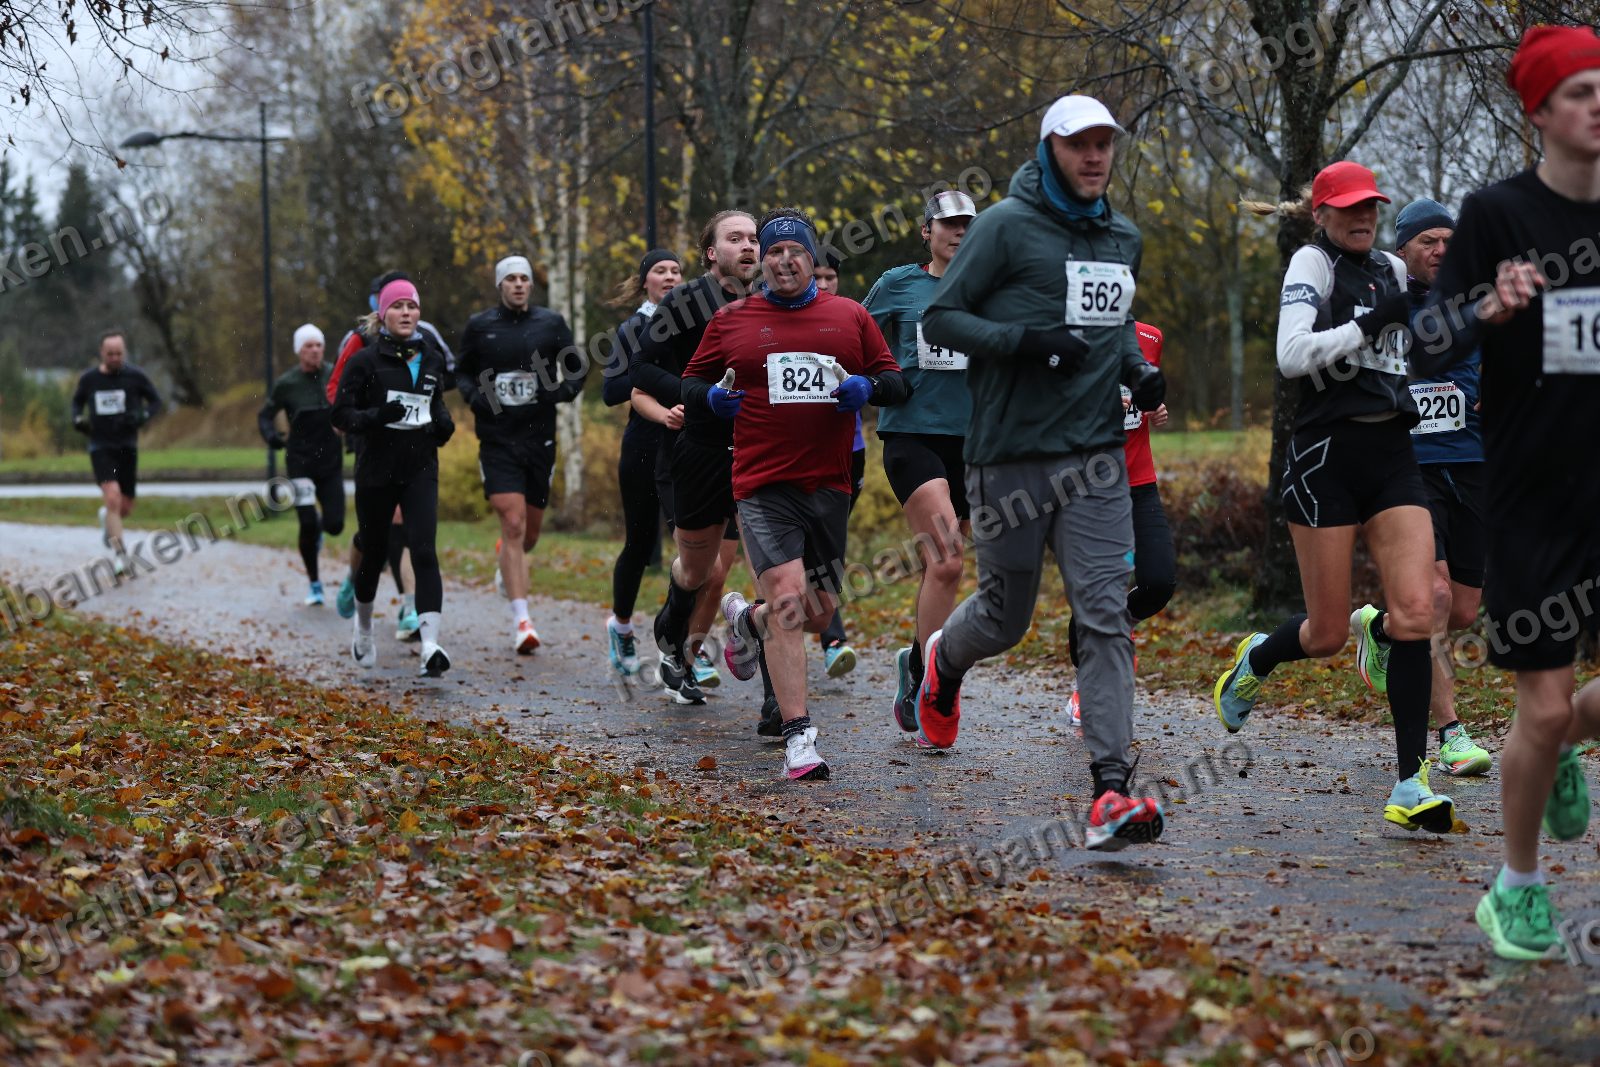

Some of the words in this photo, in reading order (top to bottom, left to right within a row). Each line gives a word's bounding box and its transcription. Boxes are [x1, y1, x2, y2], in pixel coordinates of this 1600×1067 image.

[1081, 281, 1123, 313] 562
[497, 381, 535, 397] 9315
[782, 367, 826, 393] 824
